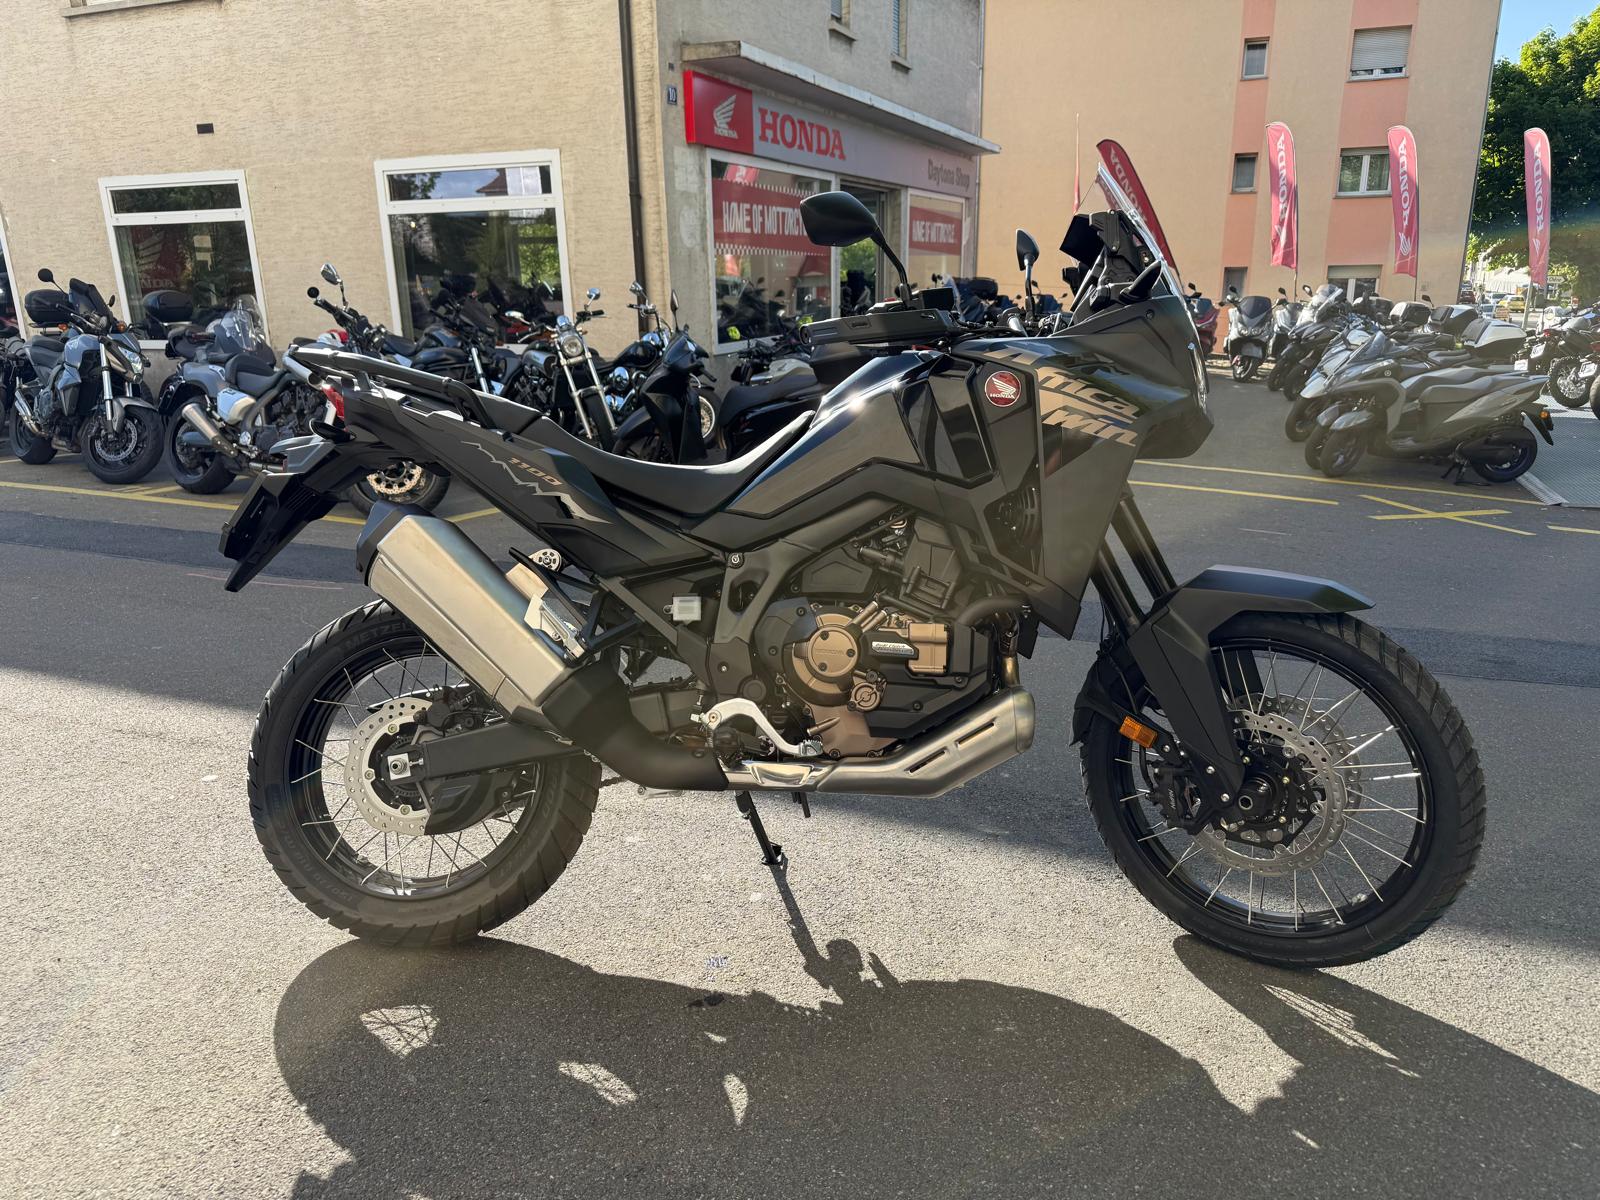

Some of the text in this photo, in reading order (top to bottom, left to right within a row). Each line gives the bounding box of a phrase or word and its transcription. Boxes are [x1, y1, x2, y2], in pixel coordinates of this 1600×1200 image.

[758, 107, 846, 160] HONDA
[955, 166, 970, 192] Shop
[1533, 140, 1544, 232] HONDA
[722, 200, 752, 234] HOME
[752, 204, 763, 234] OF
[989, 392, 1015, 400] HONDA
[509, 457, 562, 486] 1100
